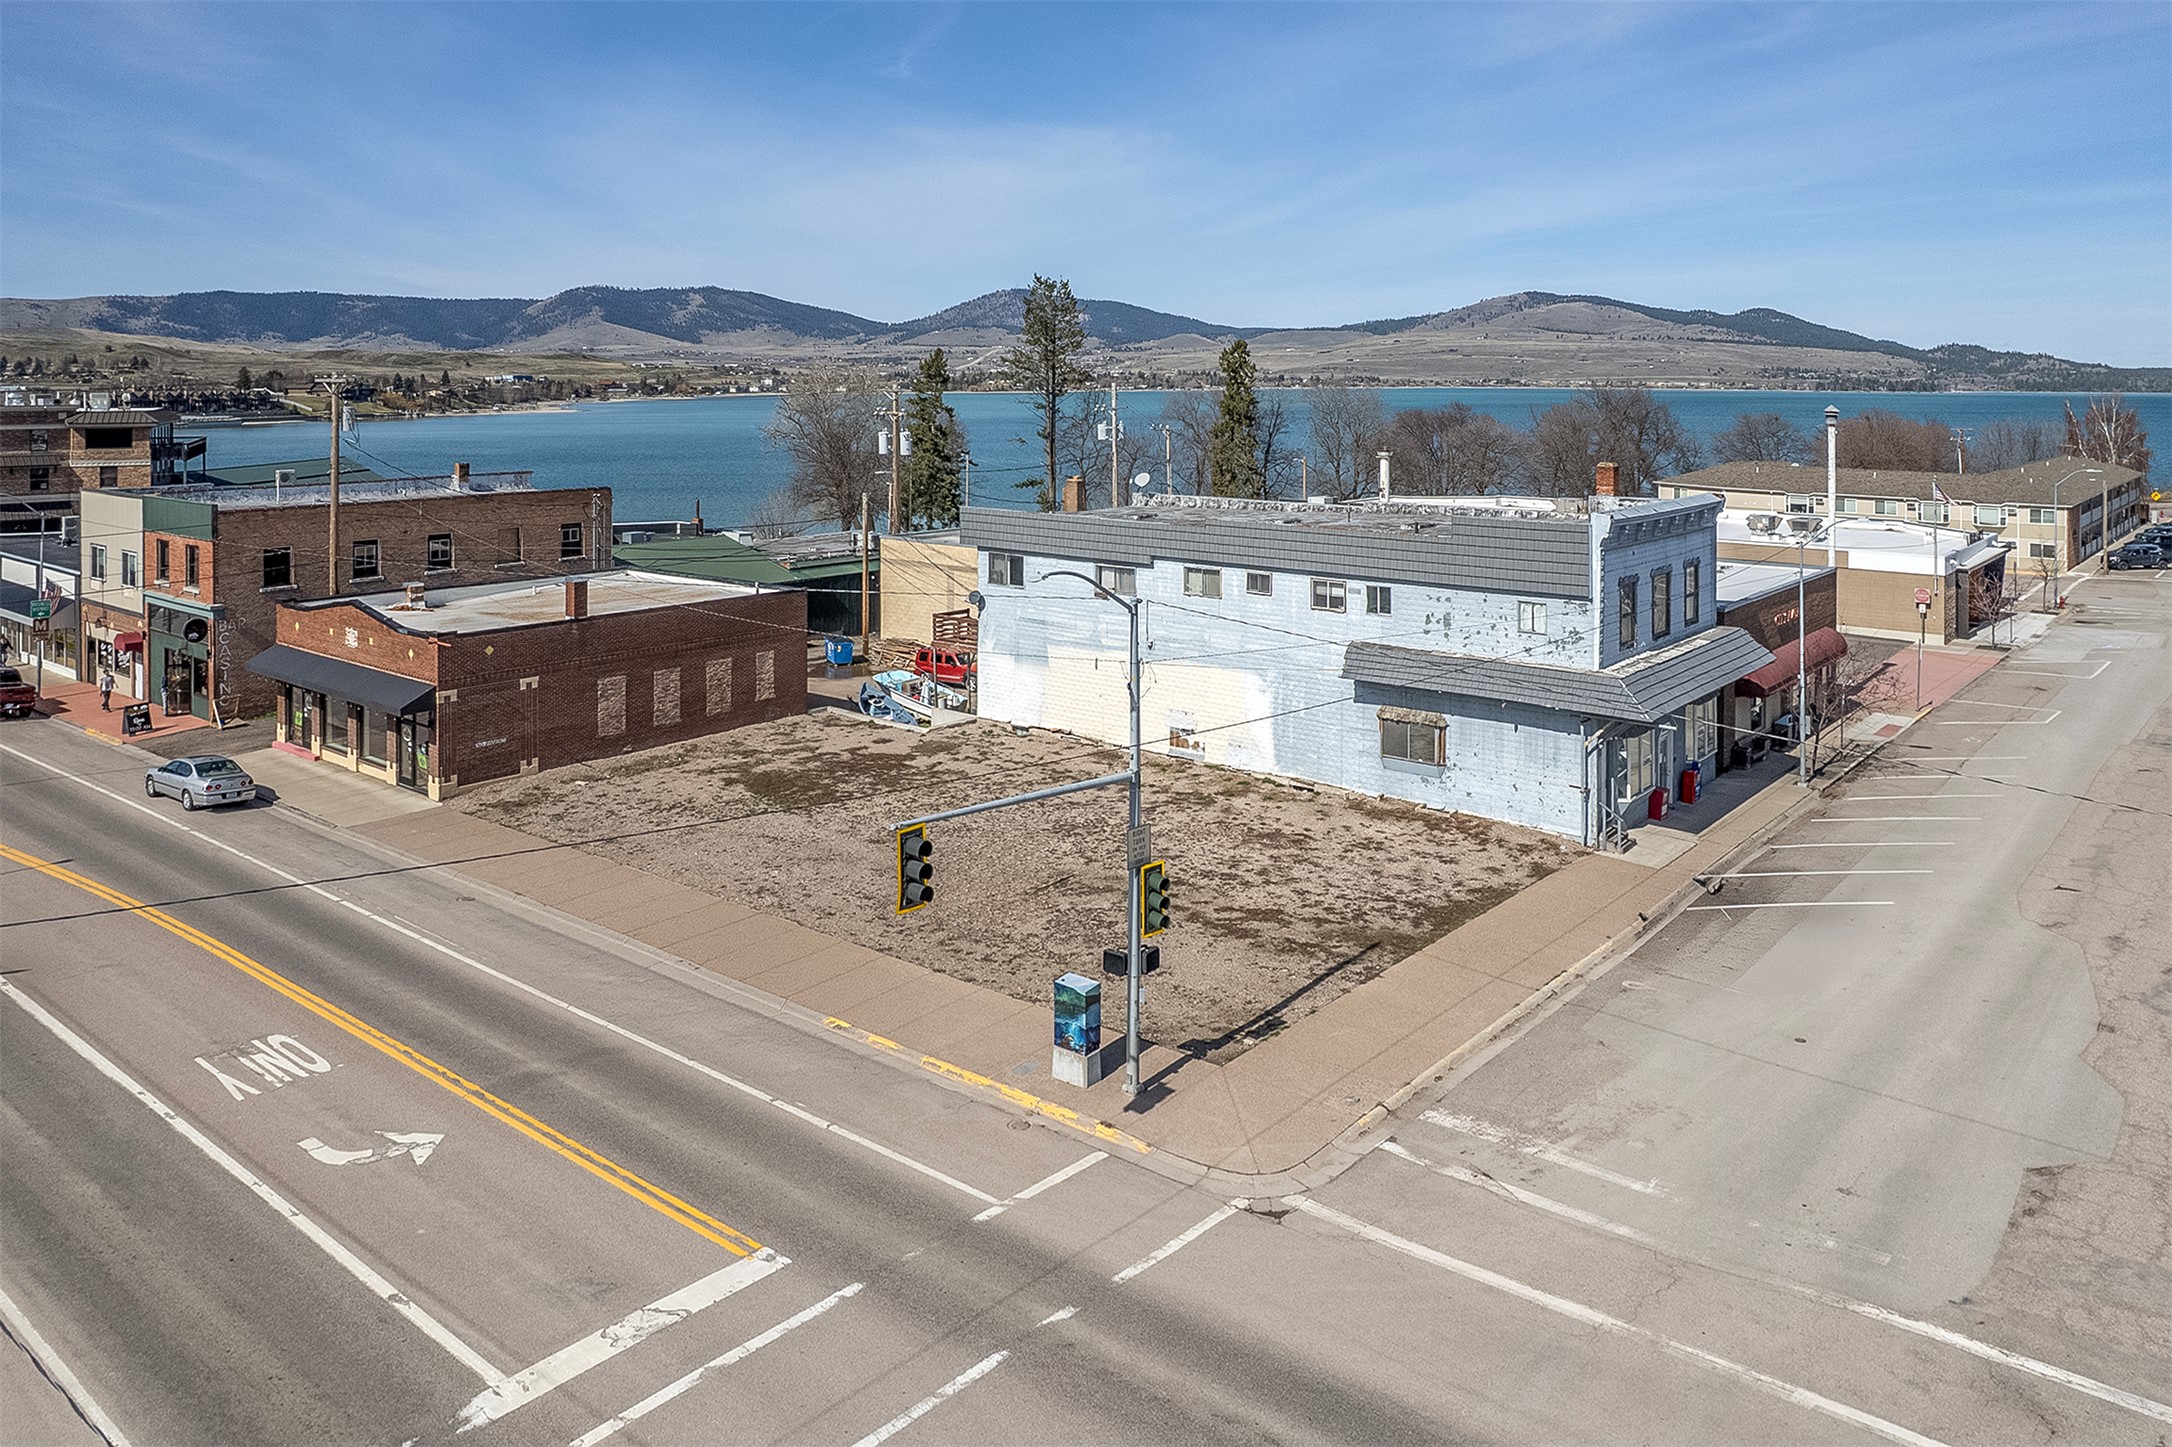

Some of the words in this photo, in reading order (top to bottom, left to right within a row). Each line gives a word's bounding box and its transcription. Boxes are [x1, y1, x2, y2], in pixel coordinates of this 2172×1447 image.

[35, 620, 47, 631] M
[219, 617, 247, 632] BAR
[219, 632, 231, 706] CASINO
[1133, 837, 1145, 846] TURN
